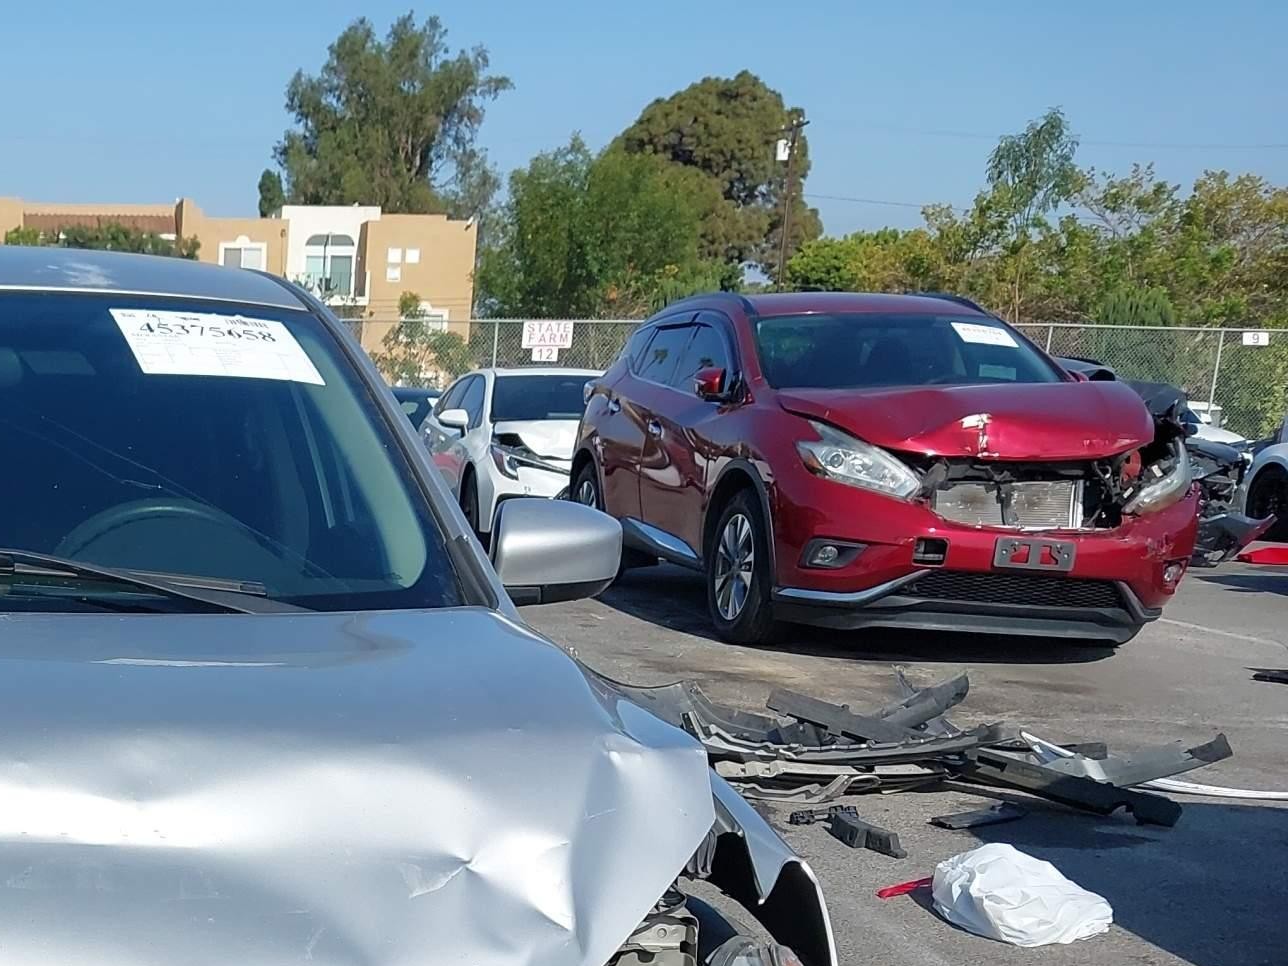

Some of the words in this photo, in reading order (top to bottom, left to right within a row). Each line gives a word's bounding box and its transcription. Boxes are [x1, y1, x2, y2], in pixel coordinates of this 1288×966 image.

[527, 323, 571, 333] STATE
[528, 333, 568, 343] FARM
[1252, 333, 1260, 344] 9
[537, 348, 553, 360] 12
